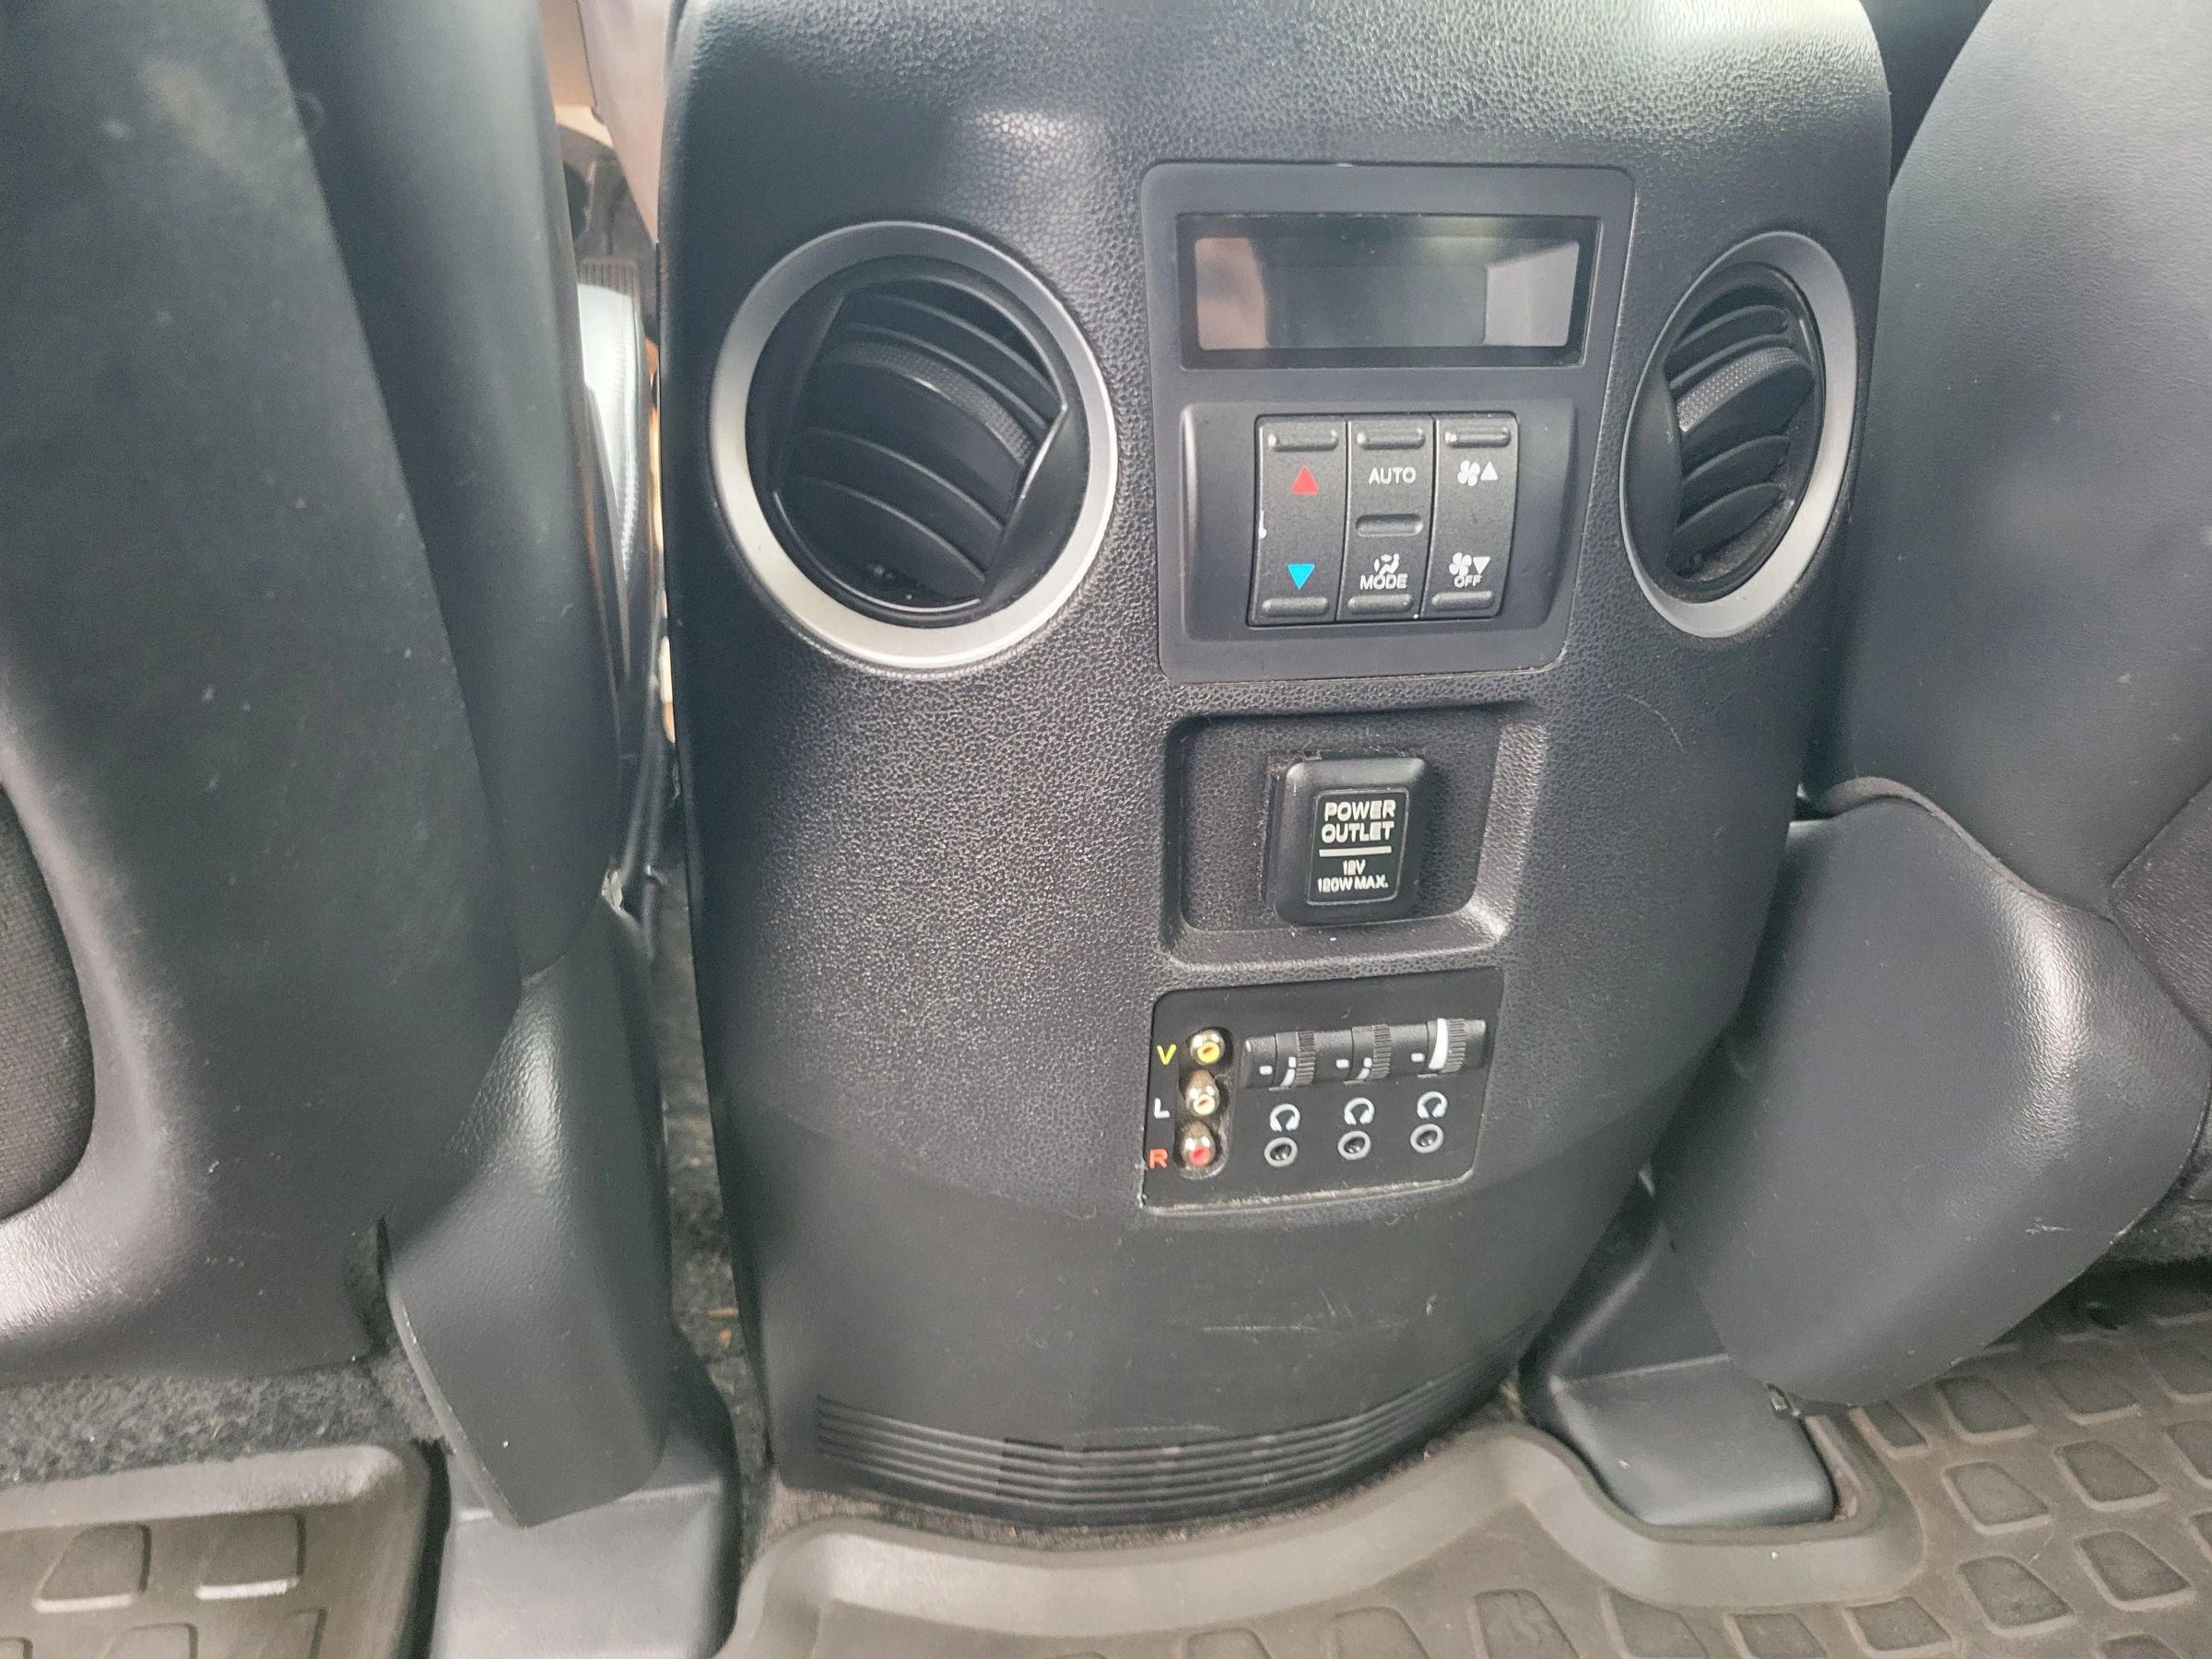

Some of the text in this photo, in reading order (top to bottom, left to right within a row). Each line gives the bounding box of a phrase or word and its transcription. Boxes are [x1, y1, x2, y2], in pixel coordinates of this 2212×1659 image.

[1368, 466, 1416, 484] AUTO
[1359, 573, 1407, 589] MODE
[1453, 574, 1481, 587] OFF
[1324, 799, 1395, 820] POWER
[1322, 820, 1394, 842] OUTLET
[1354, 875, 1388, 889] MAX.
[1157, 1043, 1176, 1065] V
[1154, 1098, 1169, 1118] L
[1148, 1148, 1169, 1168] R
